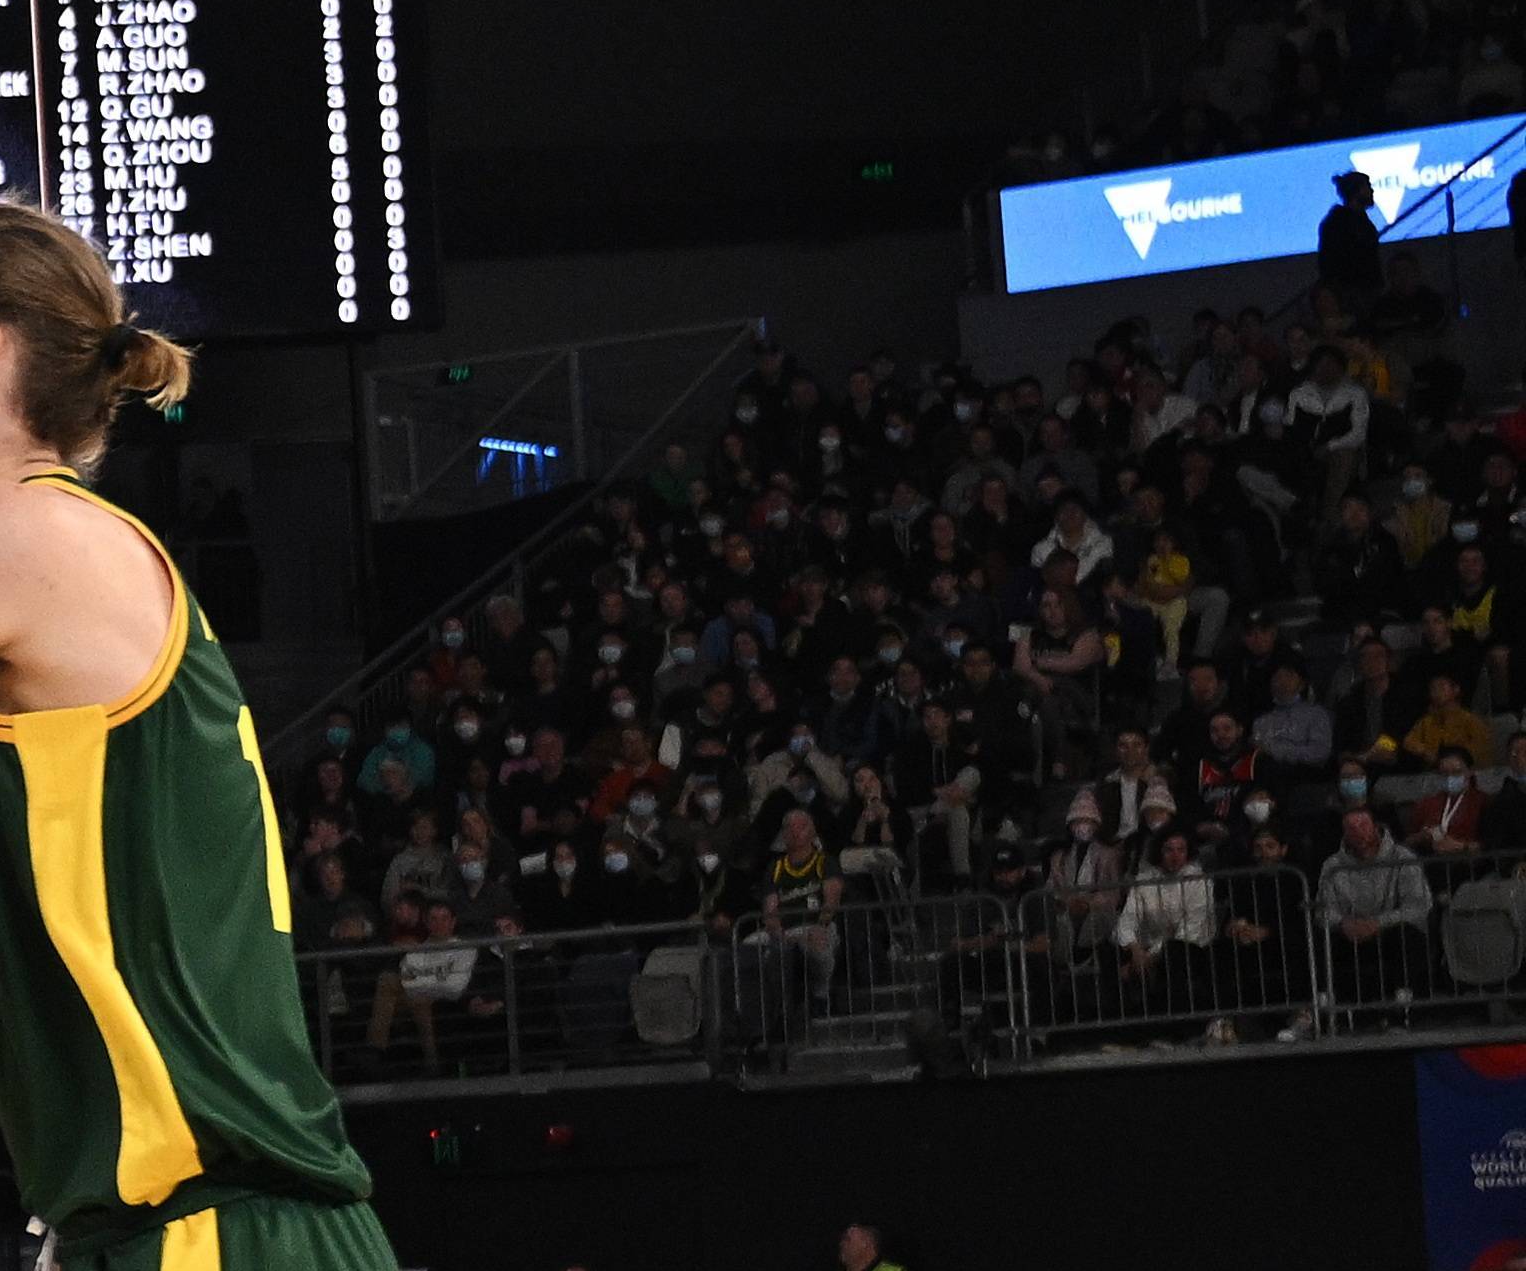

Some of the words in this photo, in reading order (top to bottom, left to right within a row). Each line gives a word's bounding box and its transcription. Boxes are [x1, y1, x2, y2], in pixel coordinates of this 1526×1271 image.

[58, 6, 76, 29] 4
[96, 23, 187, 48] A.GUO
[60, 52, 78, 75] 7
[97, 46, 188, 72] M.SUN
[376, 38, 395, 61] 0
[61, 76, 79, 99] 8
[99, 68, 205, 96] R.ZHAO
[377, 61, 397, 82] 0
[379, 83, 398, 106] 0
[57, 98, 89, 122] 12
[100, 94, 173, 120] Q.GU
[328, 109, 347, 133] 0
[380, 107, 399, 131] 0
[58, 124, 89, 146] 14
[101, 115, 214, 143] Z.WANG
[381, 130, 401, 152] 0
[103, 139, 212, 167] Q.ZHOU
[383, 154, 402, 178] 0
[59, 171, 93, 195] 23
[104, 164, 176, 190] M.HU
[331, 180, 351, 203] 0
[384, 178, 403, 201] 0
[106, 186, 187, 214] J.ZHU
[106, 211, 173, 236] H.FU
[333, 204, 352, 228] 0
[385, 202, 405, 226] 0
[108, 232, 212, 260] Z.SHEN
[334, 228, 354, 252] 0
[335, 252, 355, 275] 0
[388, 250, 407, 273] 0
[337, 275, 356, 298] 0
[389, 273, 409, 296] 0
[338, 299, 358, 323] 0
[391, 297, 410, 321] 0
